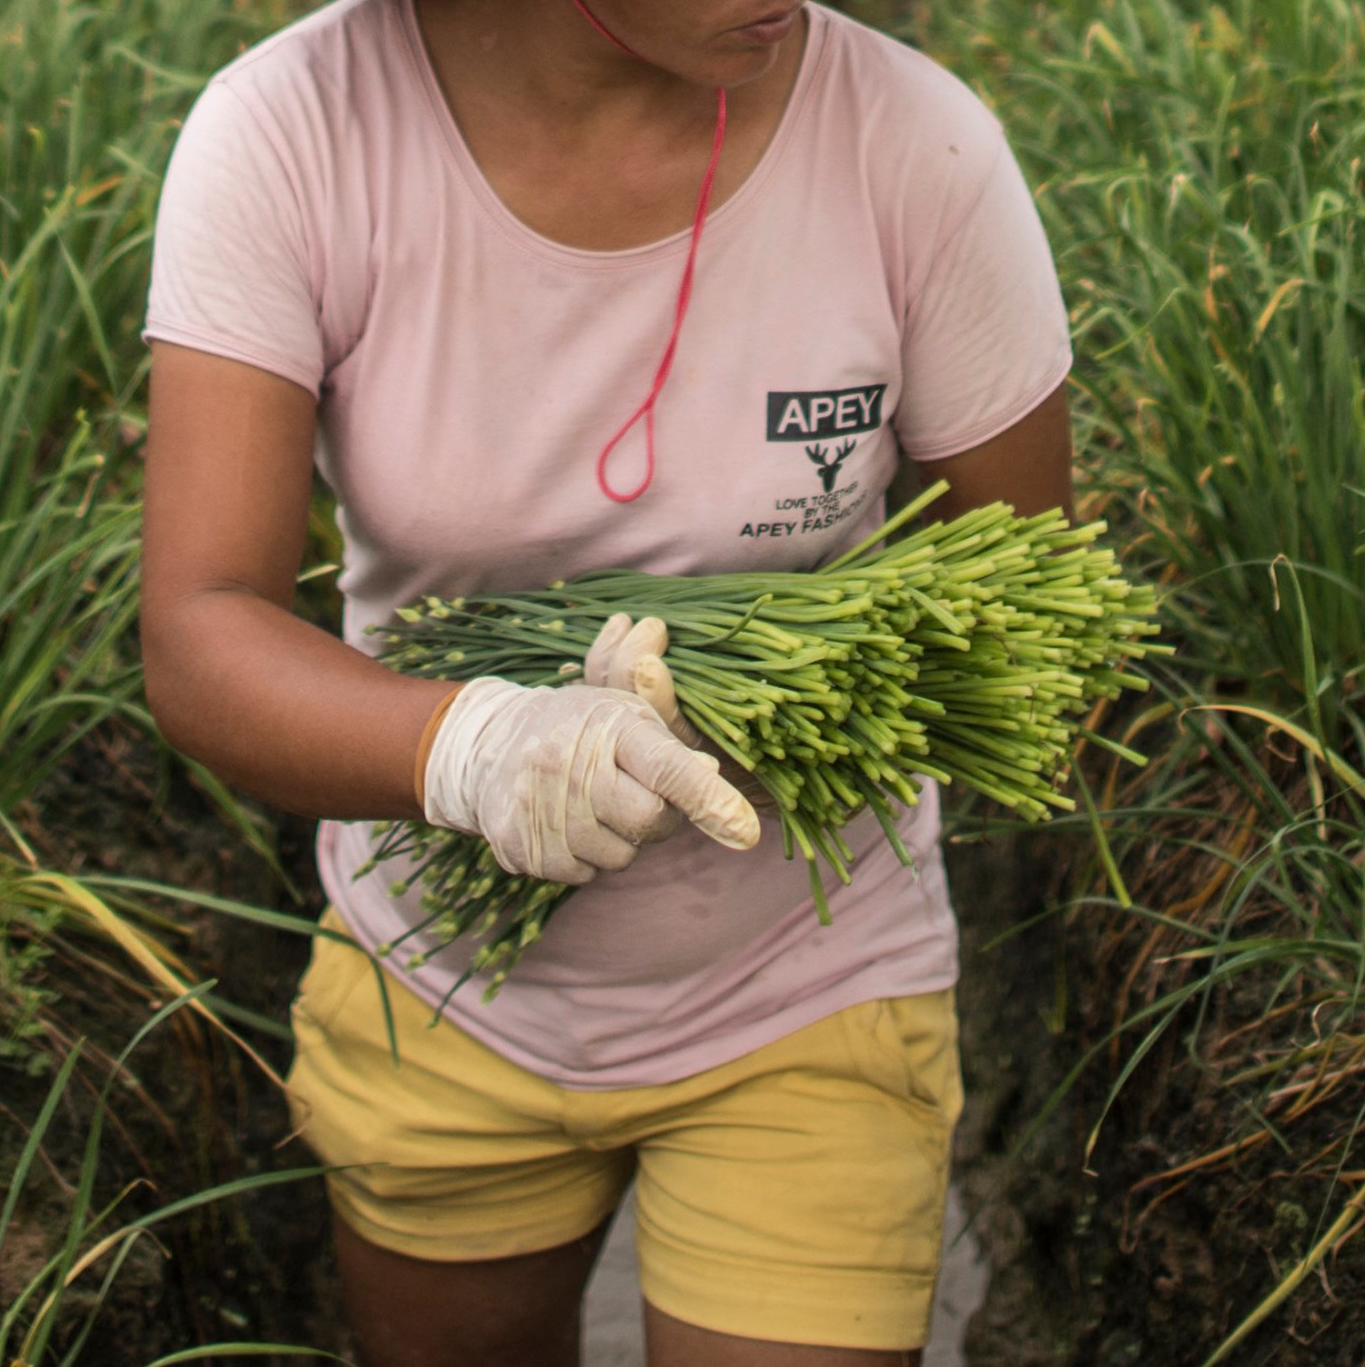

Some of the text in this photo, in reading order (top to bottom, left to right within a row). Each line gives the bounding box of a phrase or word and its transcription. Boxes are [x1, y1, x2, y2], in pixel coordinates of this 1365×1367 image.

[777, 389, 880, 434] APEY
[775, 498, 808, 511] LOVE
[821, 501, 840, 516] THE
[739, 522, 797, 538] APEY
